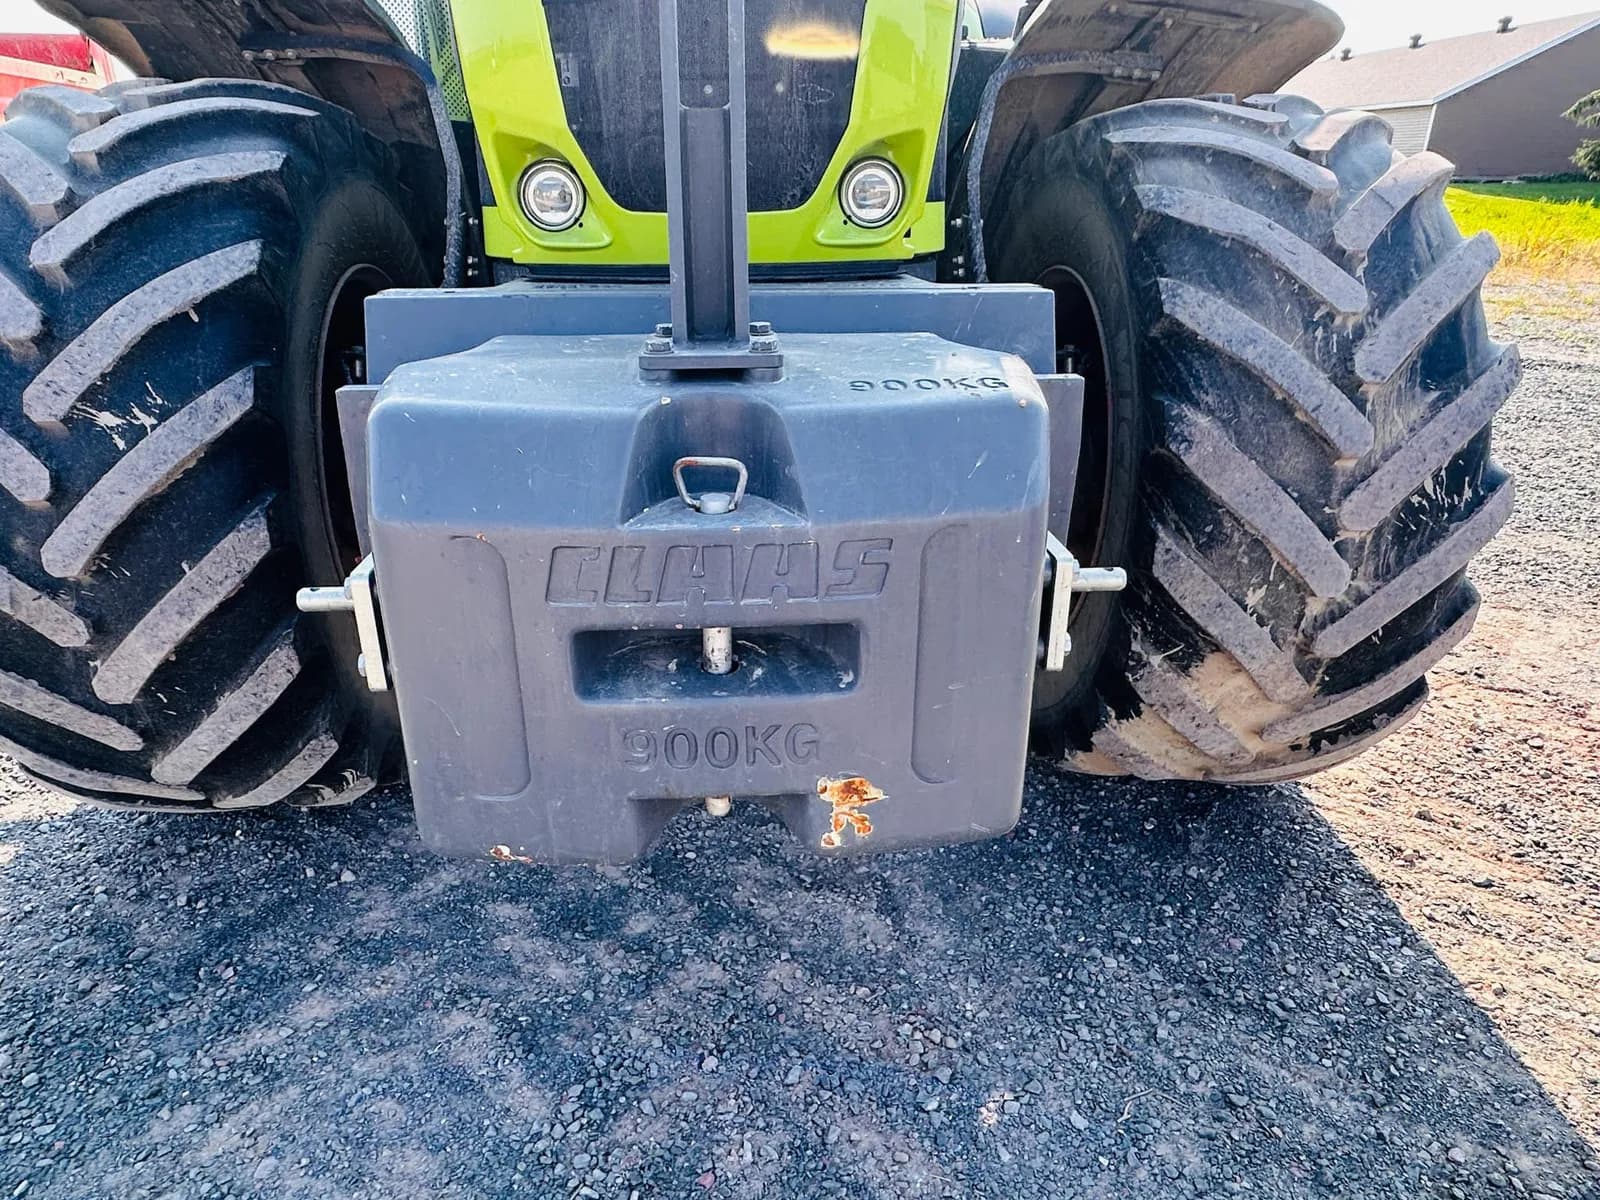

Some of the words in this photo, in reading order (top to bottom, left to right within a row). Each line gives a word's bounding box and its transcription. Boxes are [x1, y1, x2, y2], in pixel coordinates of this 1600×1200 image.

[849, 376, 1009, 393] 900KG
[546, 538, 893, 607] CLAAS
[622, 722, 821, 772] 900KG
